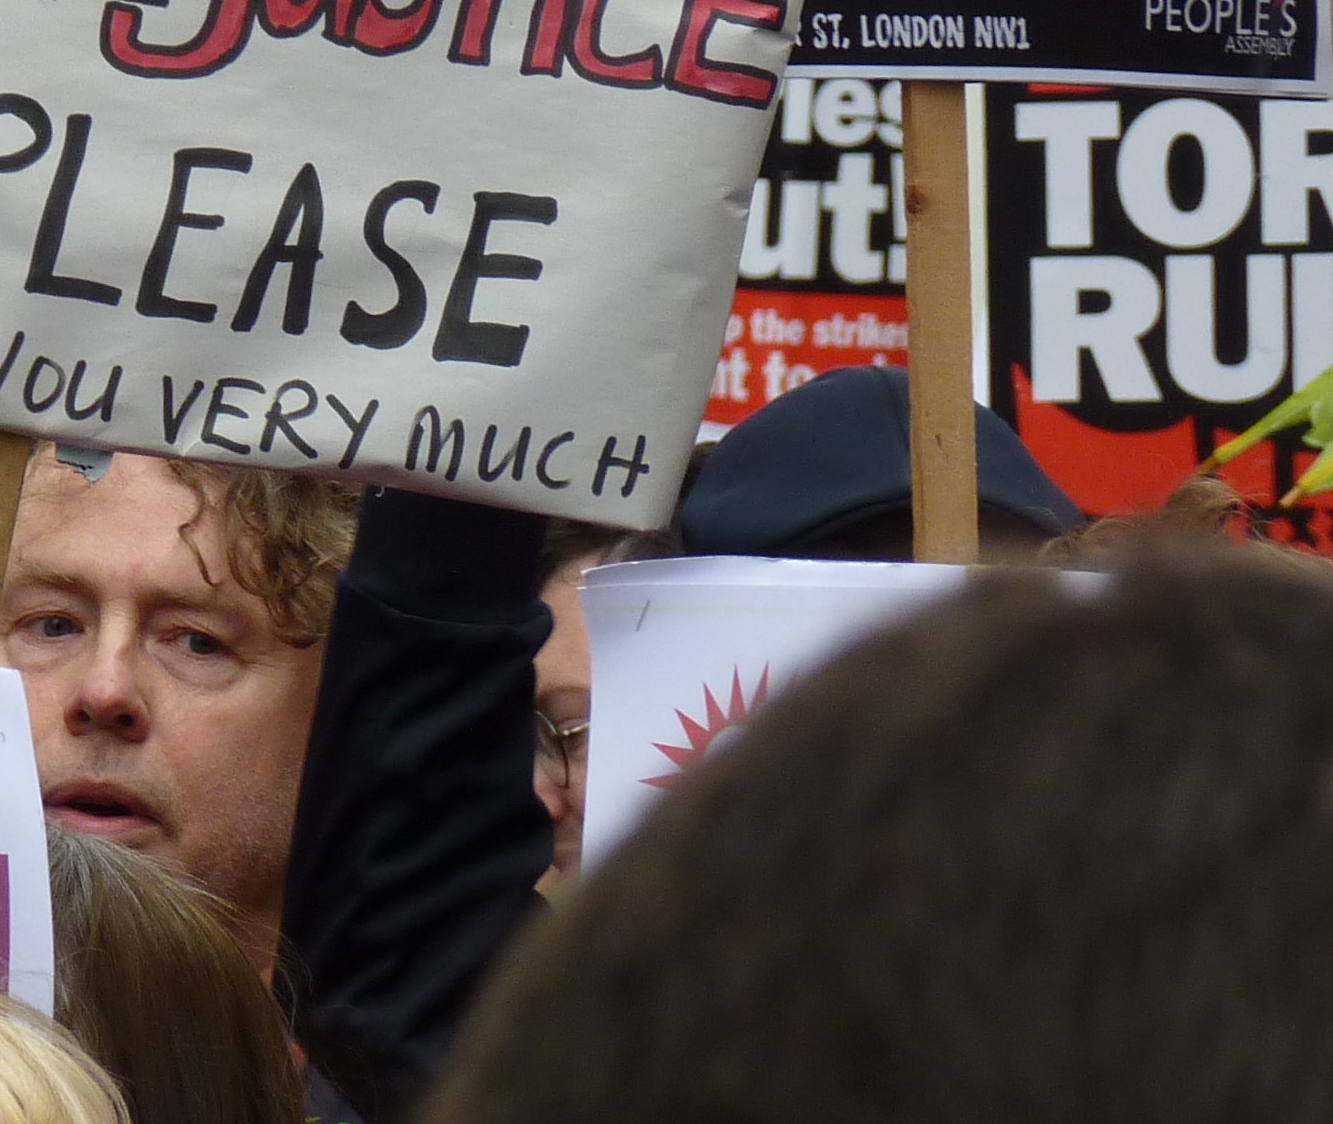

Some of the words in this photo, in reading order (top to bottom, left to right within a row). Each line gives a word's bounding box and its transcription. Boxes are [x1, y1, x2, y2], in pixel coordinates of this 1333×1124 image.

[860, 12, 965, 50] LONDON
[974, 15, 1030, 50] NW1
[1224, 35, 1297, 57] ASSEMBLY
[749, 307, 805, 346] the
[161, 374, 379, 471] VERY
[404, 404, 650, 499] MUCH
